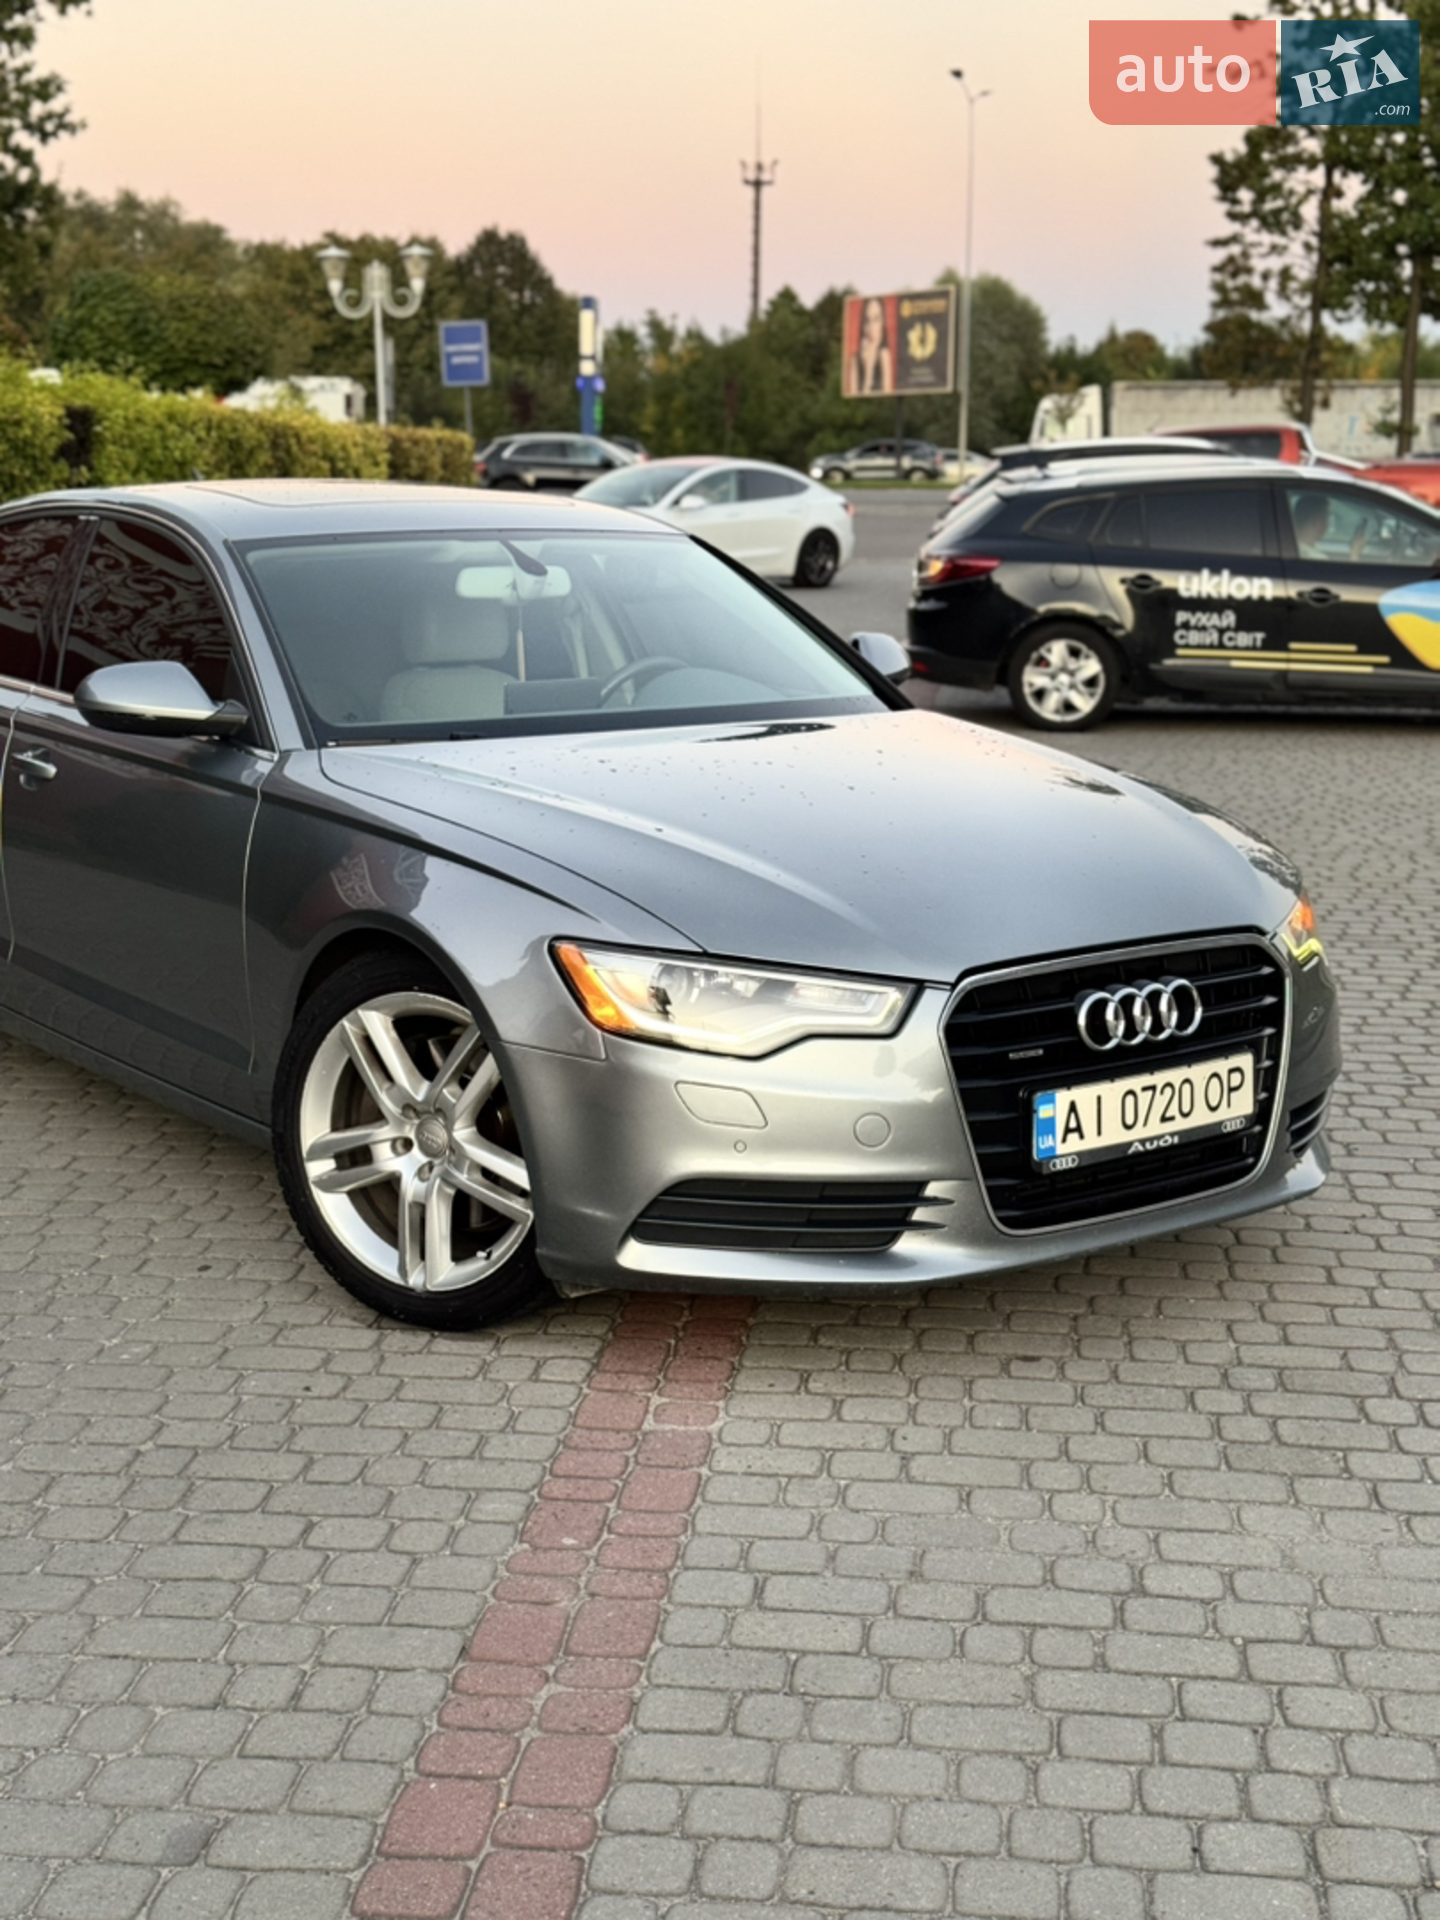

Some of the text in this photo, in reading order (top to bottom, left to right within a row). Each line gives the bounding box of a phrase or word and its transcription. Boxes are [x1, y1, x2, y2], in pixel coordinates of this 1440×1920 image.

[1178, 567, 1273, 601] uklon
[1175, 609, 1236, 629] РУХАЙ
[1173, 628, 1266, 648] СВІЙ СВІТ
[1120, 1077, 1195, 1132] 0720
[1203, 1066, 1245, 1113] OP
[1038, 1134, 1056, 1149] UA
